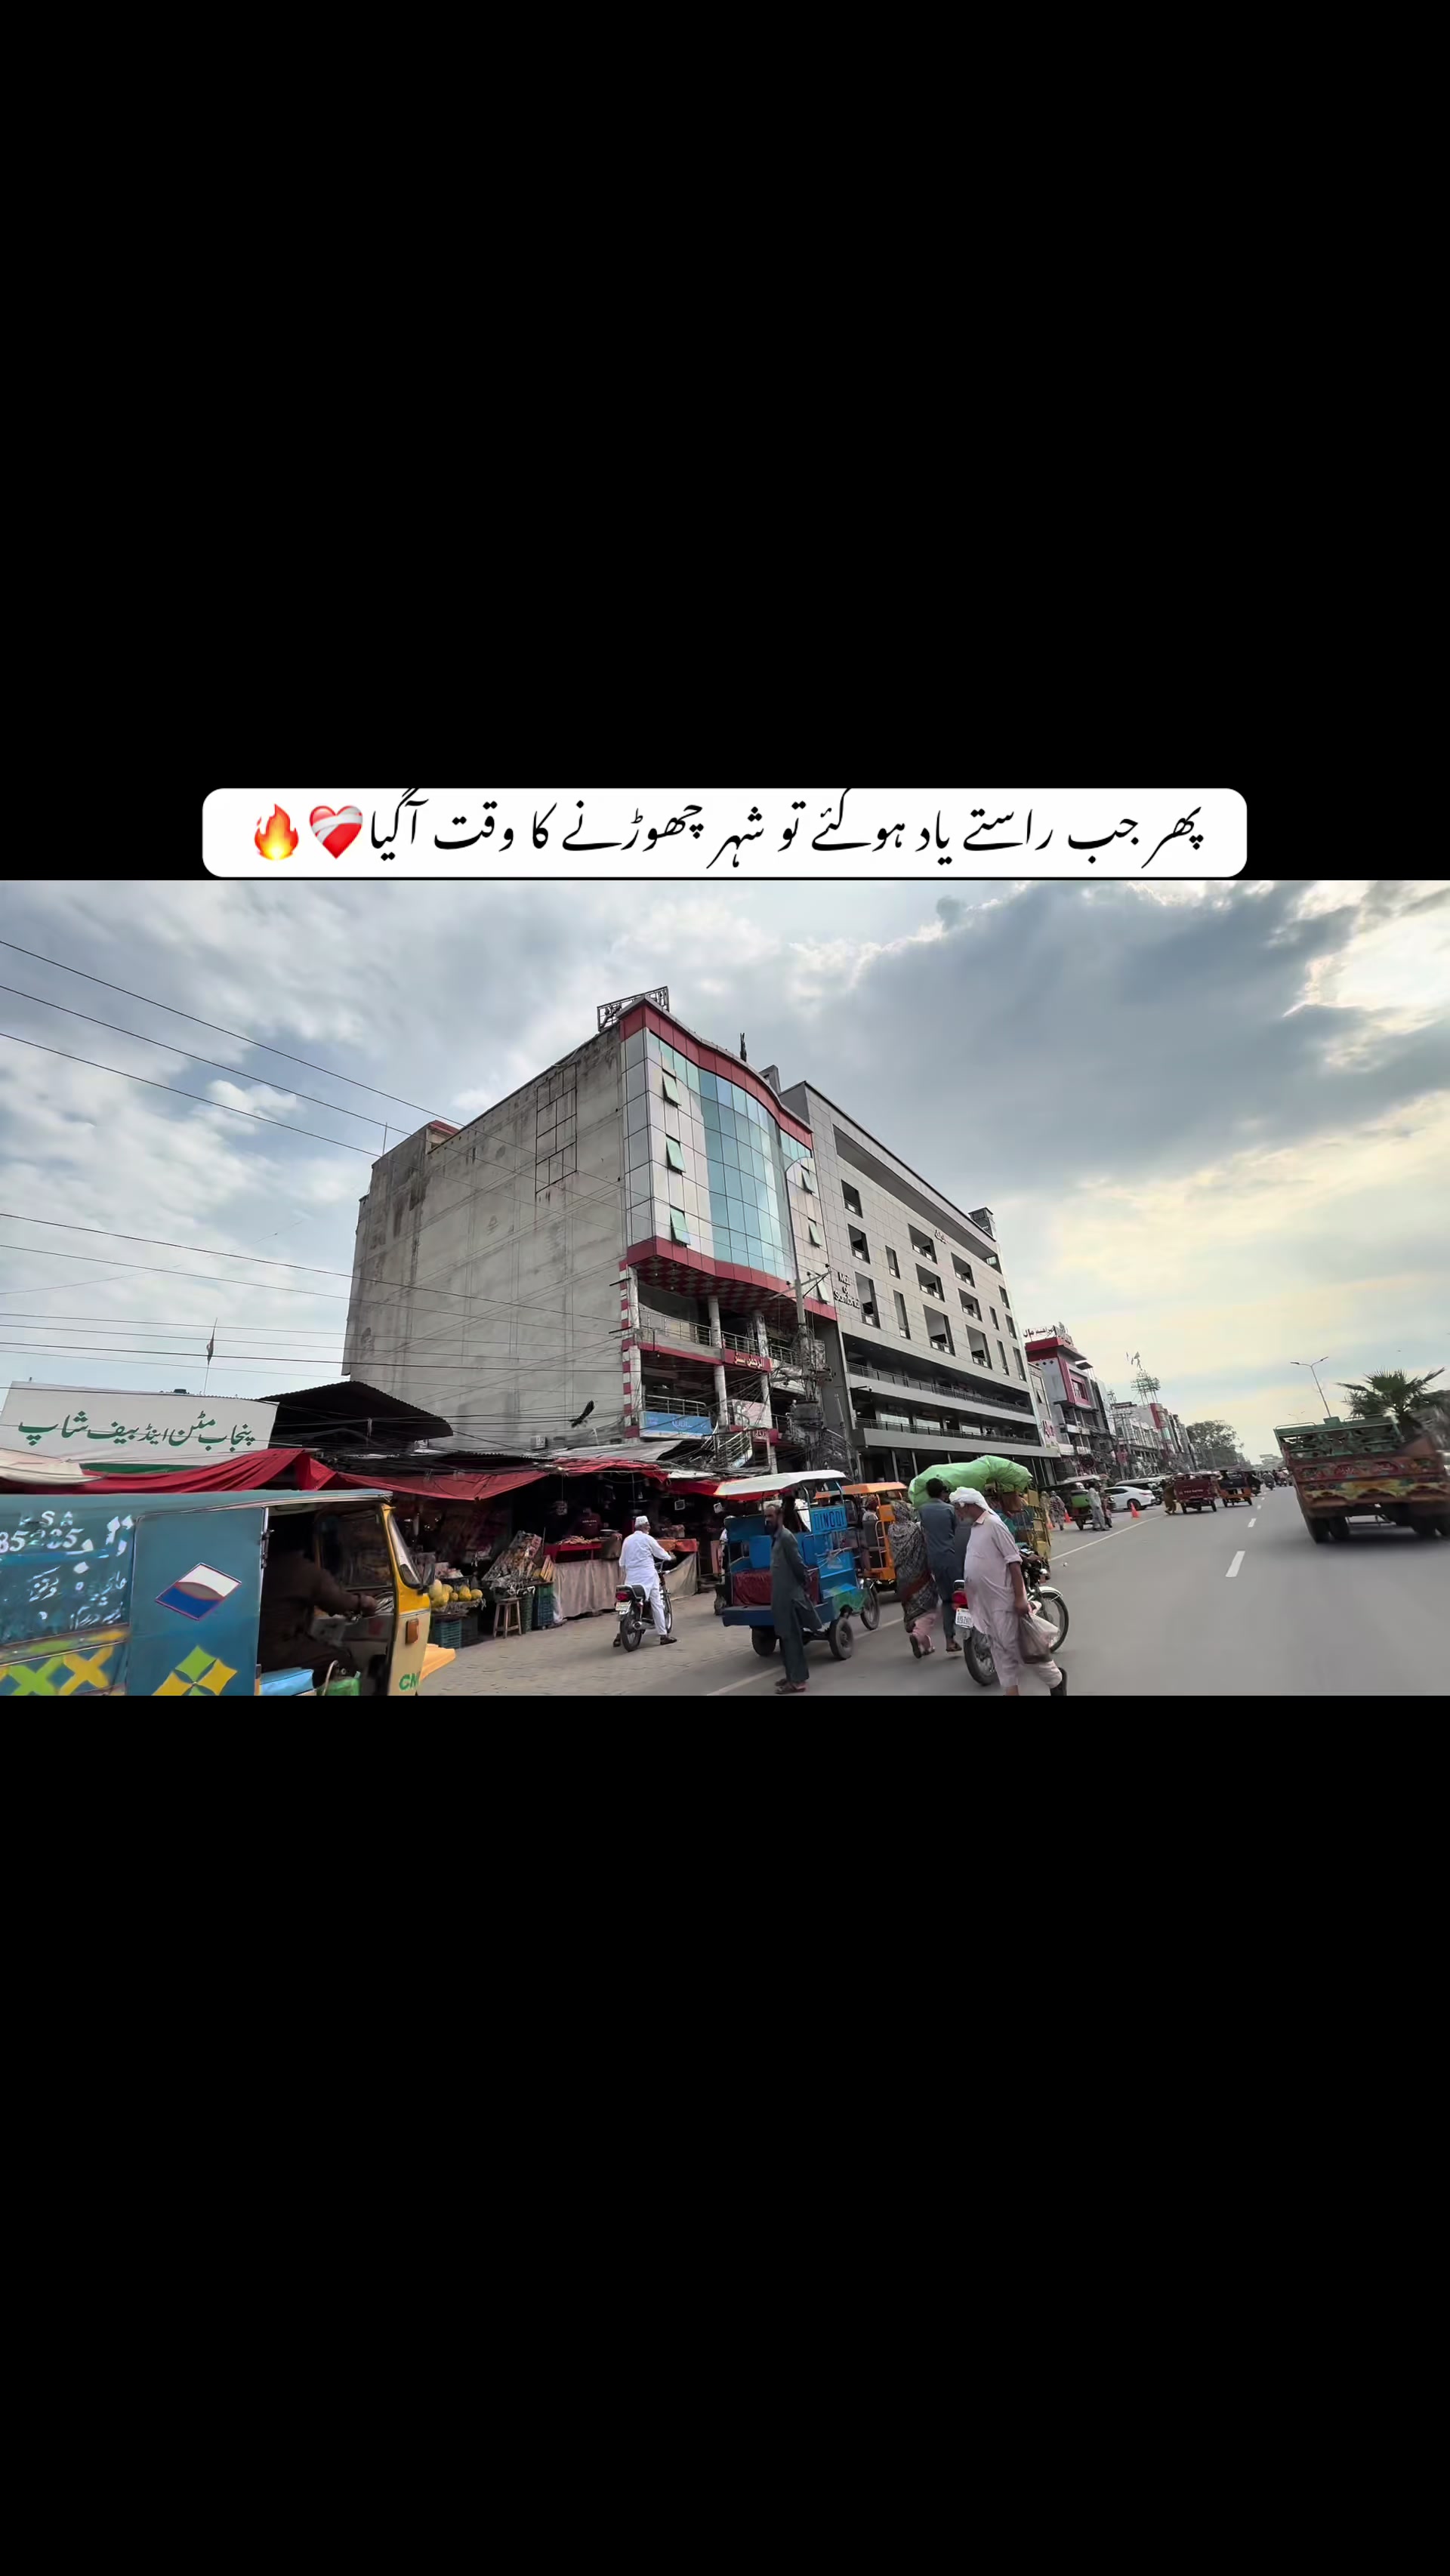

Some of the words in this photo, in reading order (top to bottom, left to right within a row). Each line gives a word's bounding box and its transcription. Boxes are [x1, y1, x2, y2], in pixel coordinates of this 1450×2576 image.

[18, 1411, 89, 1446] شاپ
[87, 1420, 140, 1444] بیف
[137, 1422, 168, 1445] اینڈ
[169, 1410, 216, 1447] مٹن
[198, 1423, 255, 1452] پنجاب
